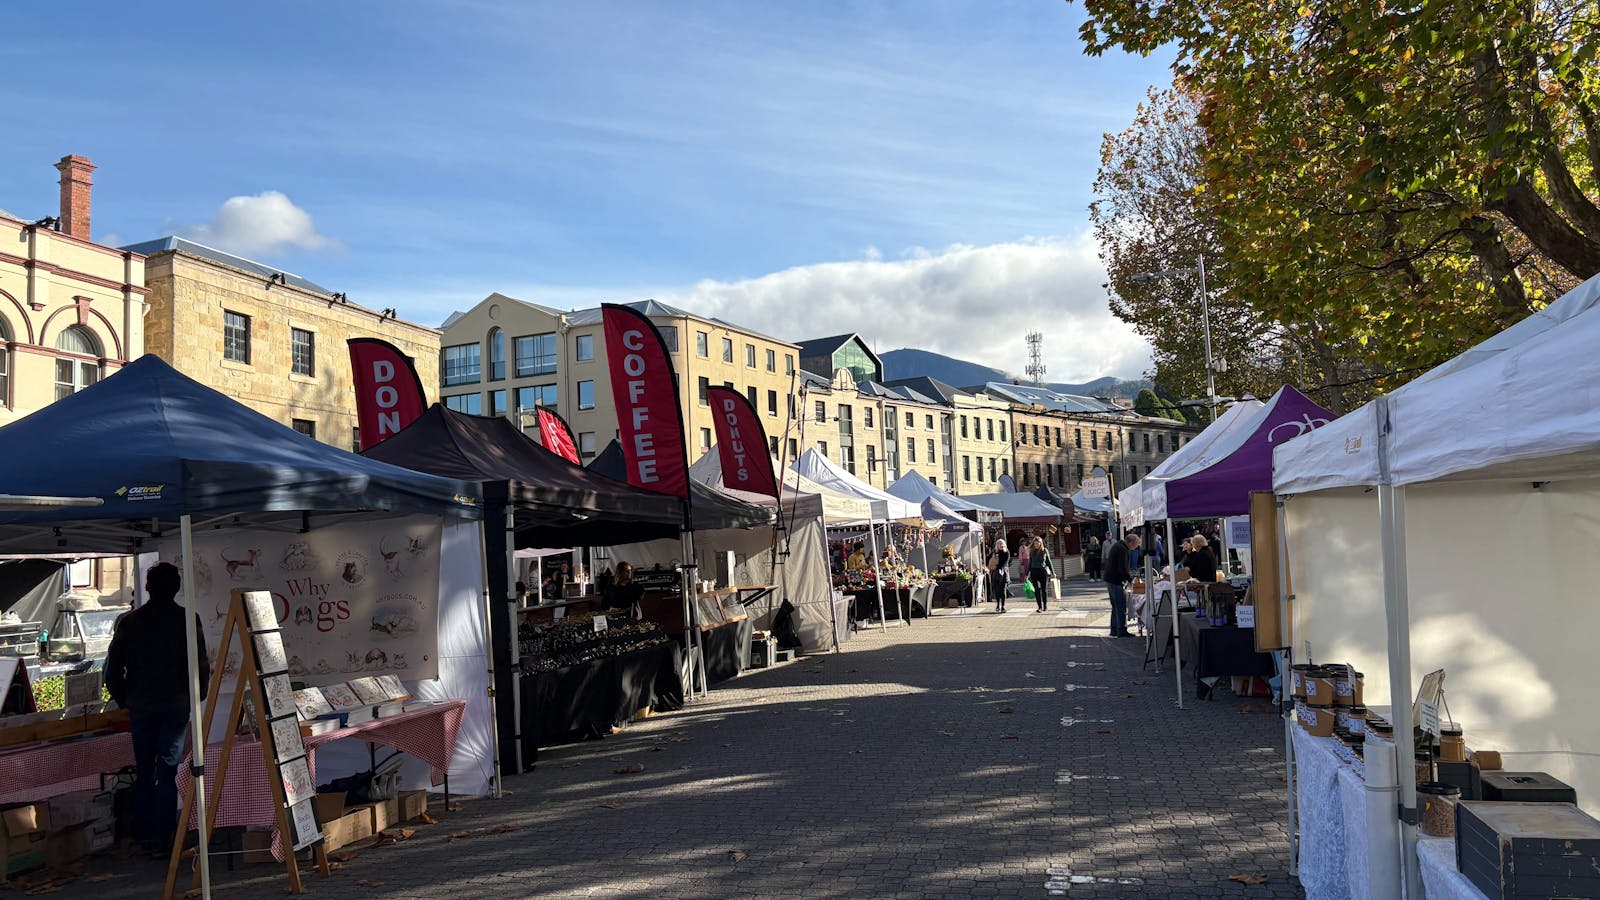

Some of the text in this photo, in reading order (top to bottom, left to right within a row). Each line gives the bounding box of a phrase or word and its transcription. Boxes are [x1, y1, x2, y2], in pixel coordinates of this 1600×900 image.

[373, 360, 401, 441] DON
[623, 329, 659, 484] COFFEE
[723, 399, 748, 481] DONUTS
[1083, 480, 1107, 488] FRESH
[1087, 488, 1106, 496] JUICE
[286, 577, 330, 600] Why
